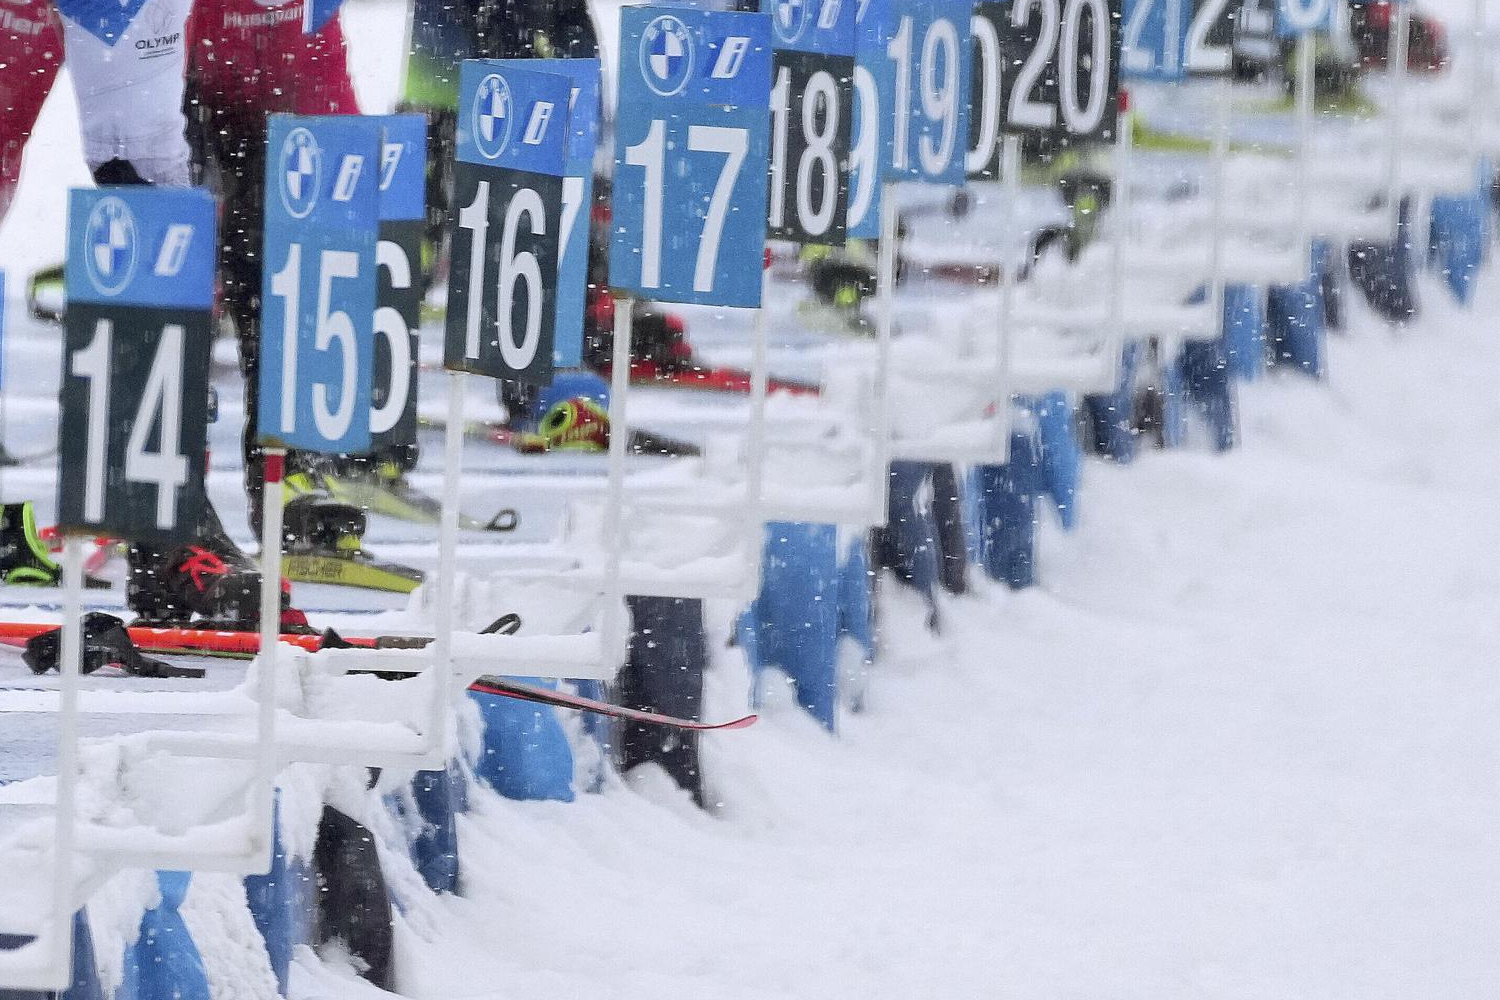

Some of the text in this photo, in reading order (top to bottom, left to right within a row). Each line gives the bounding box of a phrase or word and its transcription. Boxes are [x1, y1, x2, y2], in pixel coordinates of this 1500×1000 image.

[768, 65, 839, 237] 18
[886, 16, 961, 176] 19
[459, 180, 548, 371] 16
[625, 119, 750, 293] 17
[71, 319, 187, 531] 14
[270, 243, 359, 441] 15
